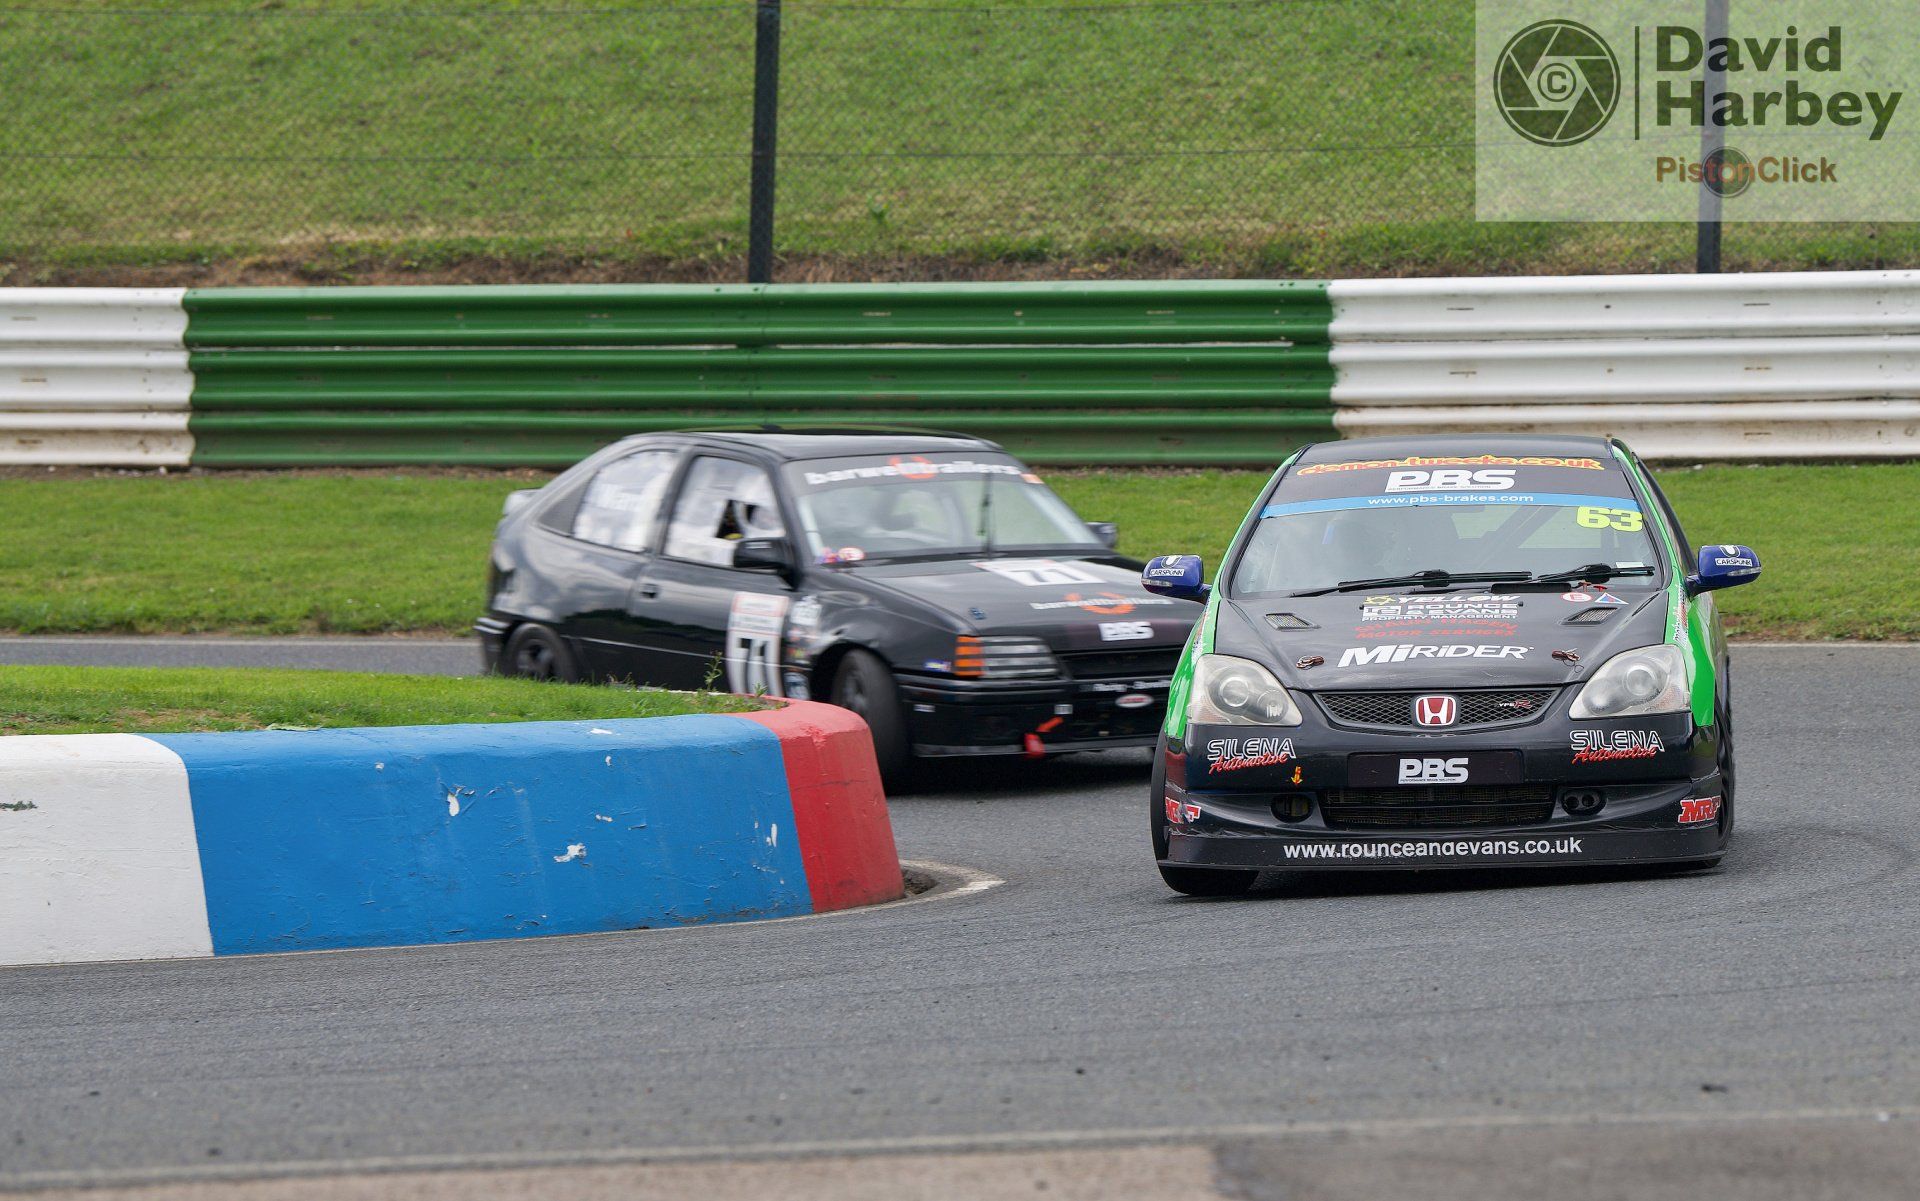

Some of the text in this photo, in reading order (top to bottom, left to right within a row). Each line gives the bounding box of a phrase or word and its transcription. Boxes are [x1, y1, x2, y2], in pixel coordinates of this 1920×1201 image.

[1297, 456, 1605, 475] demon-tweeks.co.uk
[1385, 469, 1517, 492] PBS
[1368, 494, 1534, 505] www.pbs-brakes.com
[1576, 507, 1643, 532] 63
[1006, 569, 1084, 583] 71
[1399, 595, 1520, 604] YELLOW
[1207, 738, 1296, 760] SILENA
[1570, 730, 1665, 753] SILENA
[1208, 752, 1288, 775] Automotive
[1571, 744, 1657, 764] Automotive
[1398, 757, 1469, 784] PBS
[1678, 796, 1722, 824] MRF
